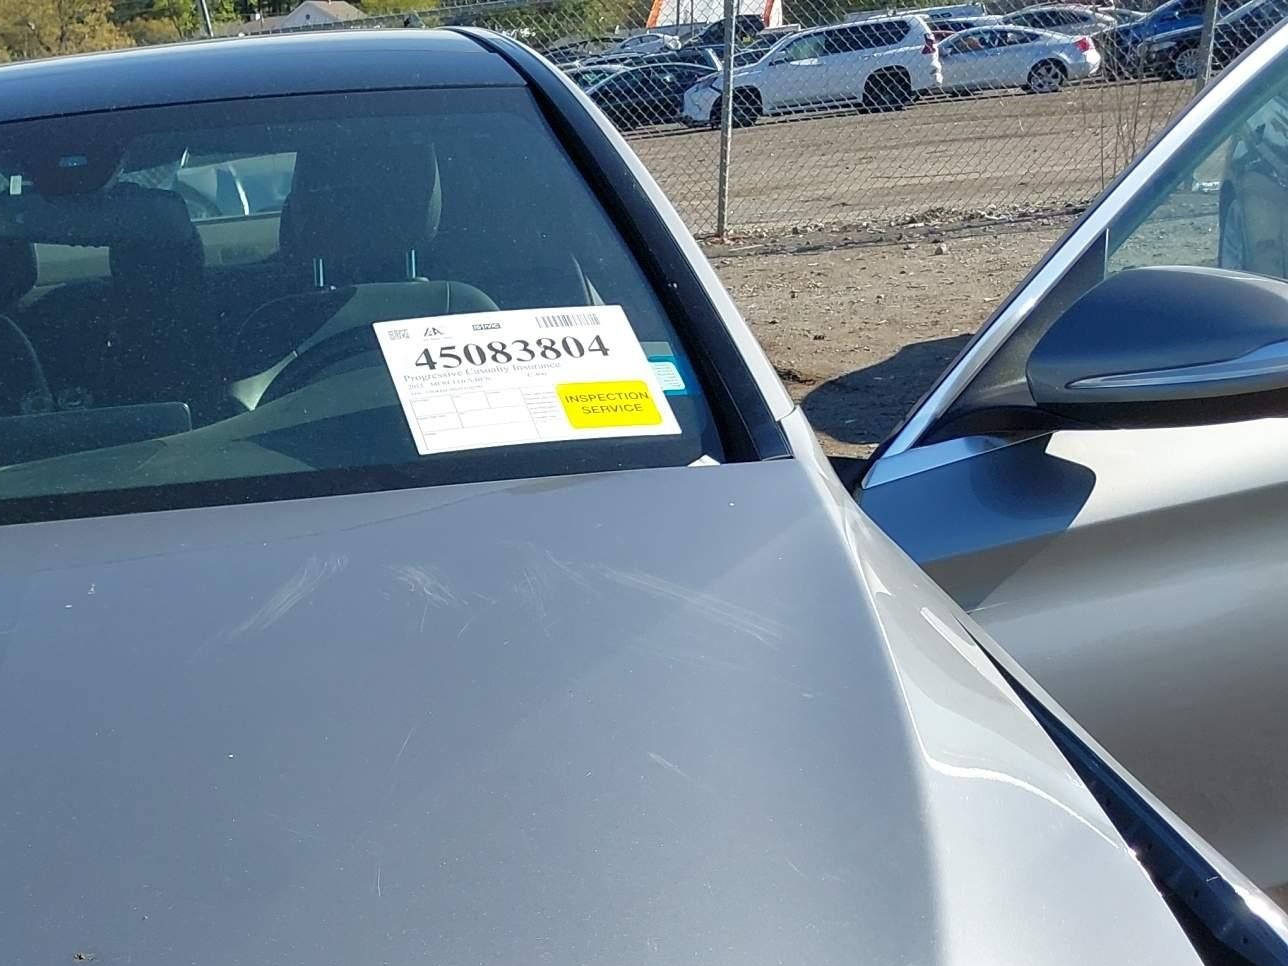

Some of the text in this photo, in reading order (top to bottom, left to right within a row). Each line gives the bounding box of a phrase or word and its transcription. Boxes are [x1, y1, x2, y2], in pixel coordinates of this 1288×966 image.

[415, 335, 610, 370] 45083804
[564, 391, 649, 403] INSPECTION
[581, 403, 644, 414] SERVICE
